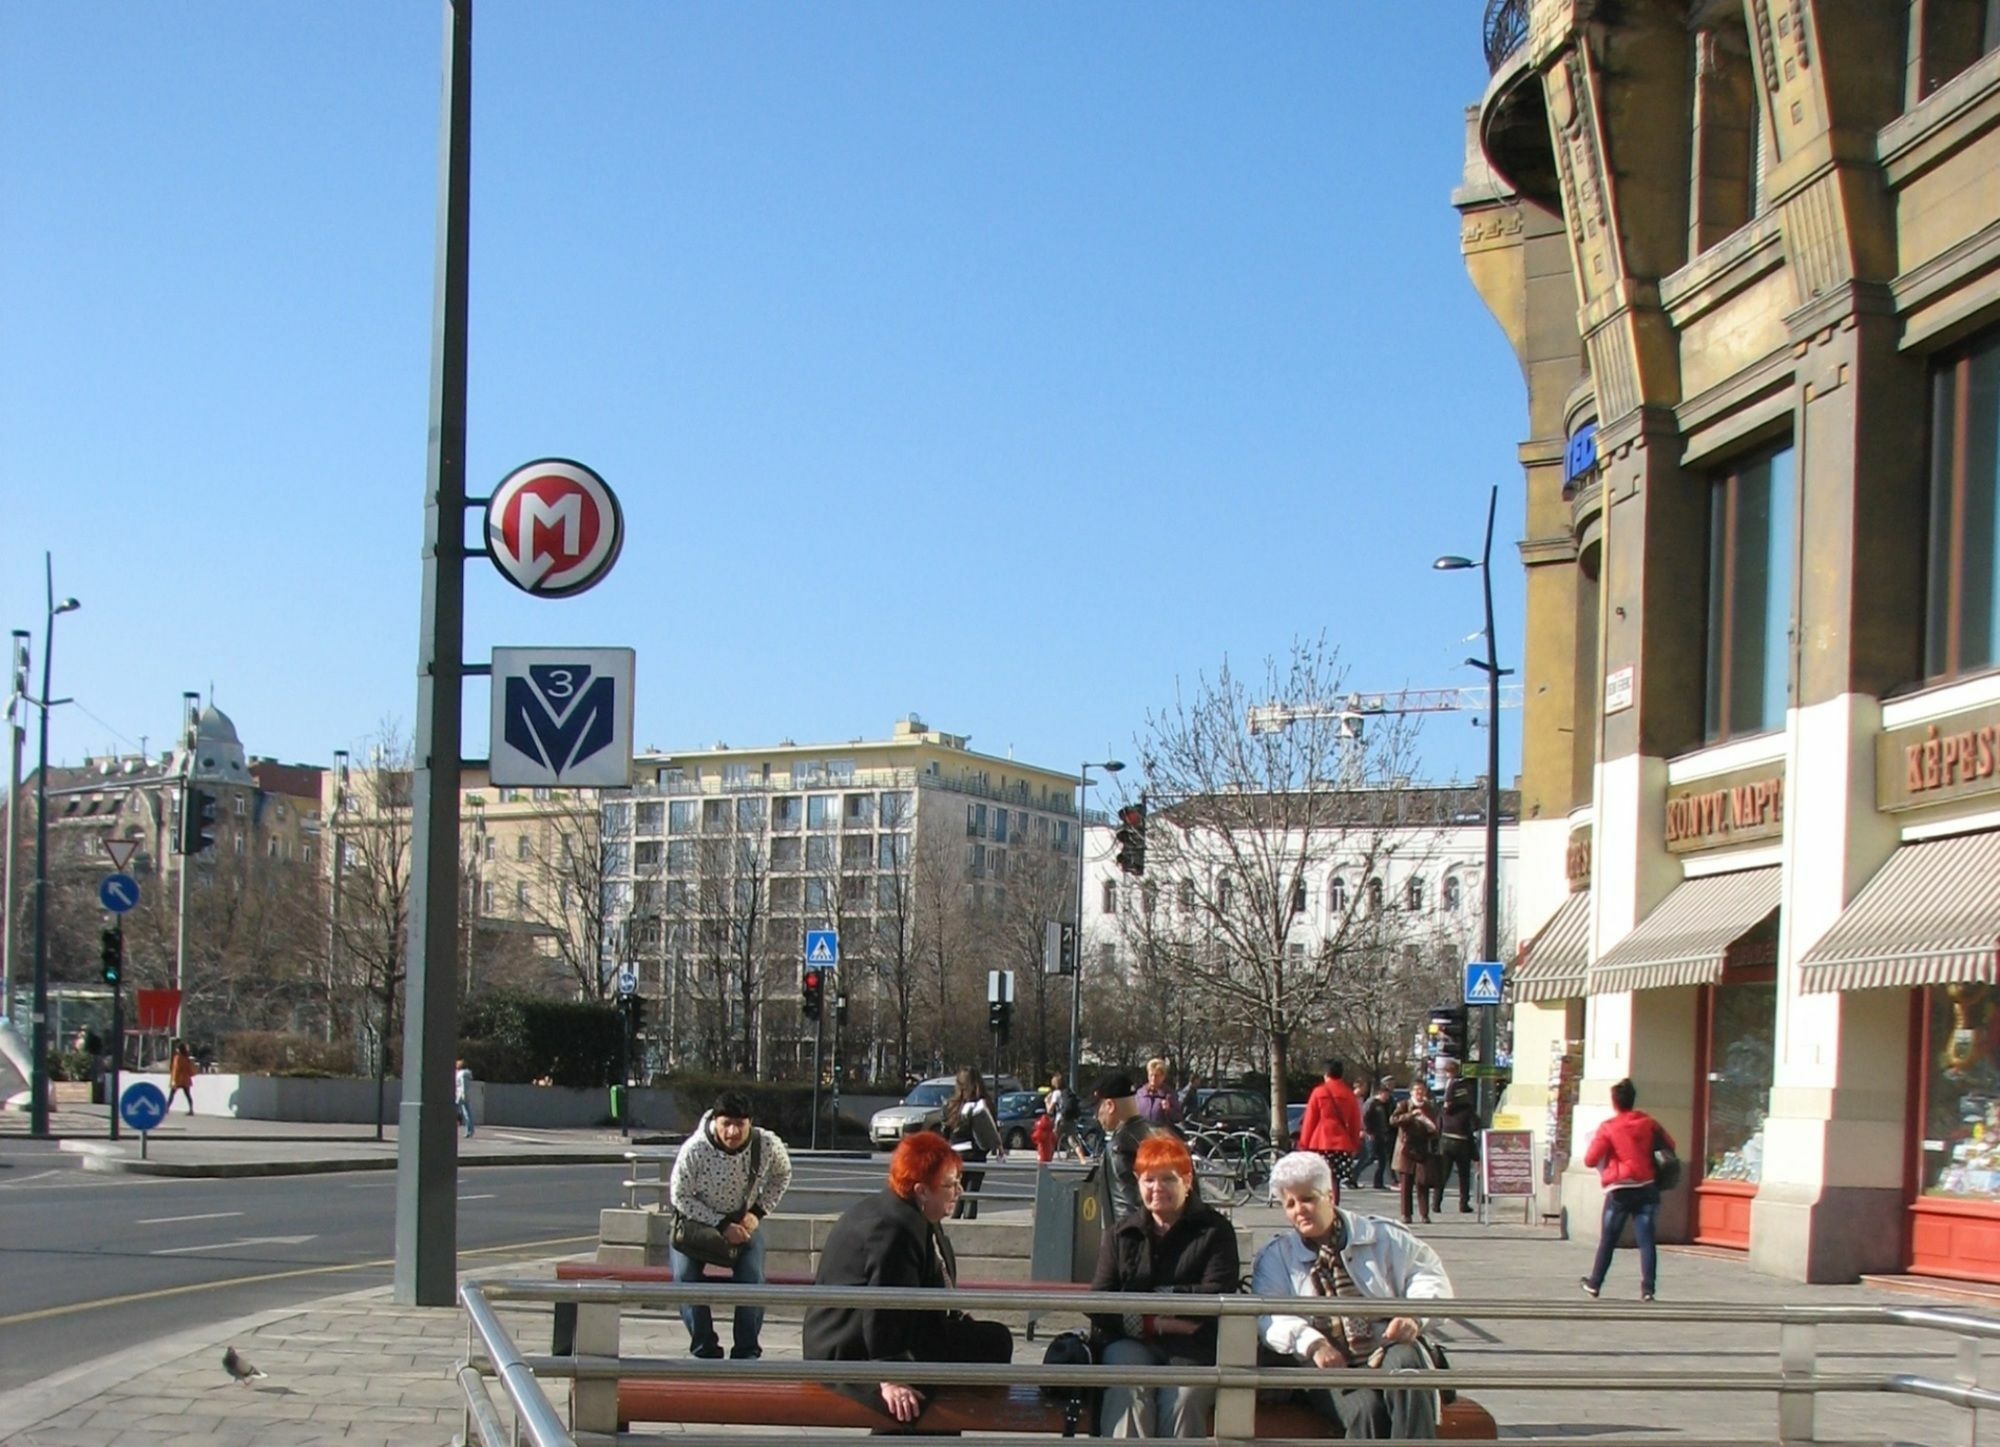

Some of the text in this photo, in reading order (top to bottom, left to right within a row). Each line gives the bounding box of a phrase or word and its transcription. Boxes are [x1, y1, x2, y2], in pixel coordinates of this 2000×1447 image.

[518, 492, 582, 590] M
[548, 671, 573, 698] 3
[1905, 722, 2000, 794] KÉPES
[1730, 777, 1784, 830] NAPT
